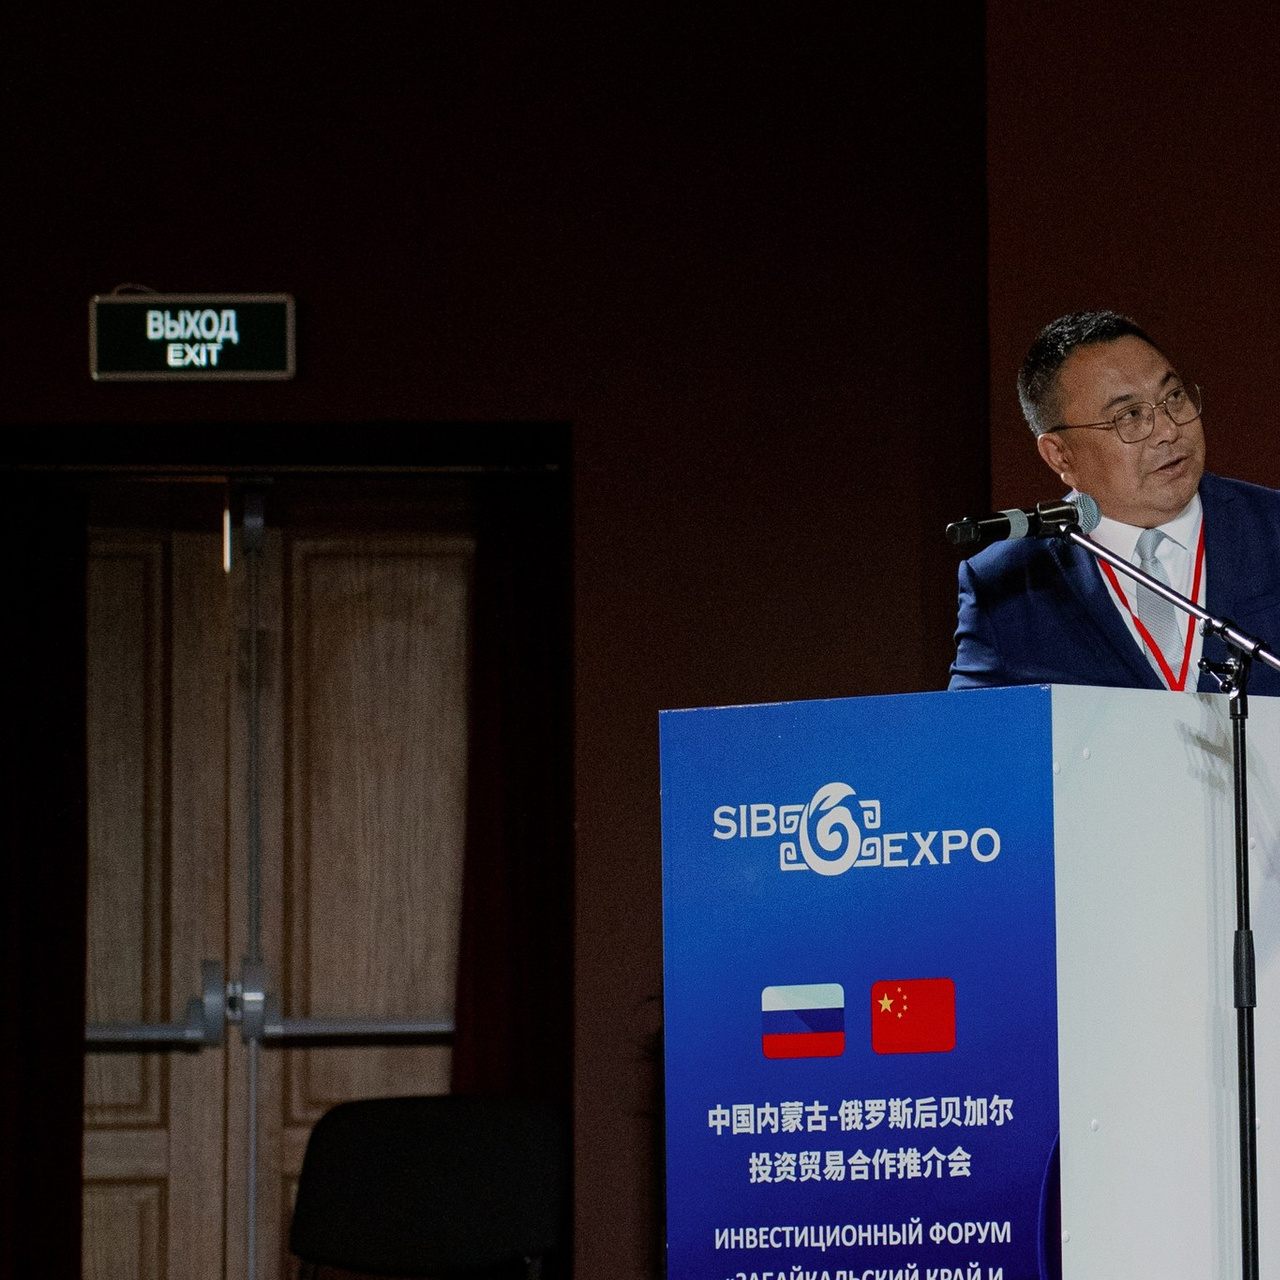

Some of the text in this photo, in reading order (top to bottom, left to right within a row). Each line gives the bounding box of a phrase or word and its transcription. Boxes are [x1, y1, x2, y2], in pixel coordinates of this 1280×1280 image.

[147, 309, 238, 344] ВЫХОД
[167, 342, 222, 367] EXIT
[883, 827, 1001, 868] EXPO
[708, 1094, 1014, 1136] 中国内蒙古-俄罗斯后贝加尔
[748, 1145, 972, 1184] 投资贸易合作推介会
[714, 1217, 1011, 1252] ИНВЕСТИЦИОННЫЙ ФОРУМ
